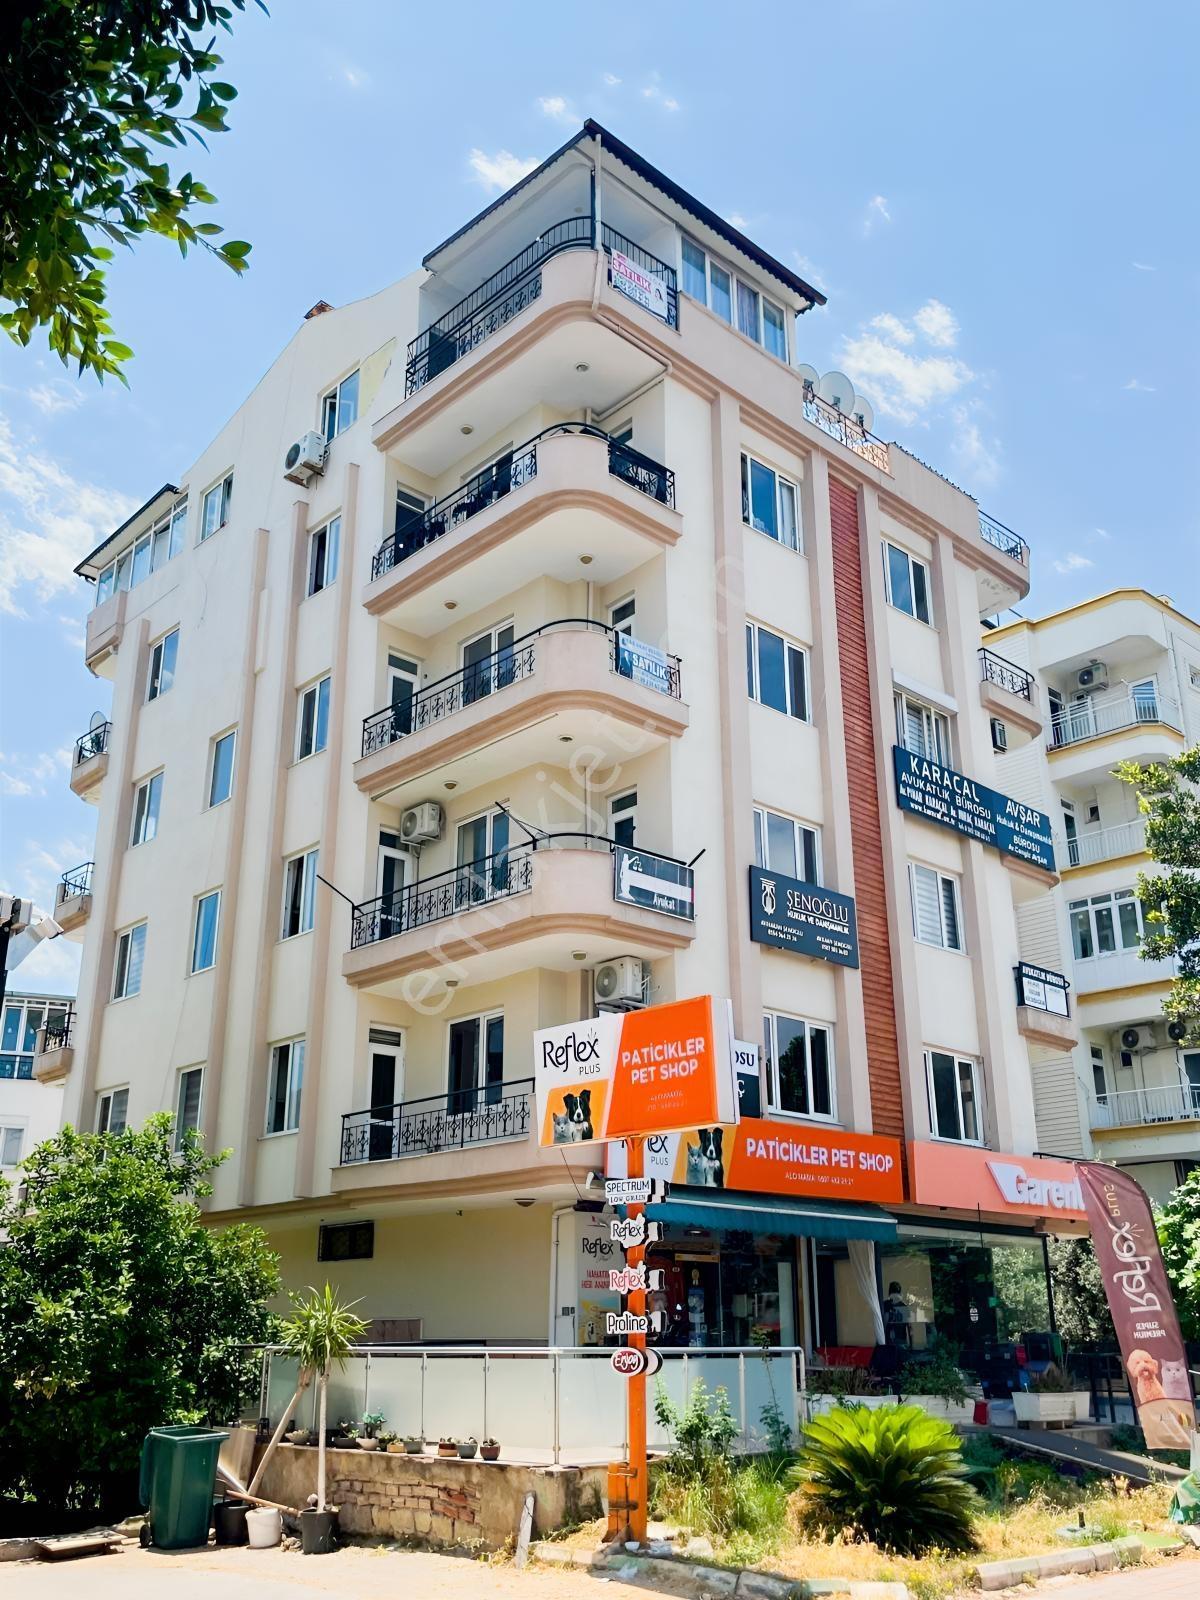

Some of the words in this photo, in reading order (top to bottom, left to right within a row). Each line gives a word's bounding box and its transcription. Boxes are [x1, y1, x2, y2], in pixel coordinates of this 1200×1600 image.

[632, 653, 668, 680] SATILIK
[901, 771, 950, 802] AVUKATLIK
[955, 794, 991, 819] BÜROSU
[1005, 799, 1041, 828] AVŞAR
[786, 889, 848, 923] ŞENOĞLU
[807, 915, 815, 925] VE
[543, 1031, 601, 1073] Reflex
[621, 1037, 705, 1068] PATİCİKLER
[579, 1063, 601, 1076] PLUS
[631, 1066, 656, 1085] PET
[660, 1059, 699, 1082] SHOP
[650, 1156, 669, 1166] PLUS
[746, 1137, 829, 1166] PATİCİKLER
[831, 1148, 856, 1169] PET
[859, 1151, 894, 1173] SHOP
[606, 1180, 650, 1193] SPECTRUM
[612, 1222, 642, 1240] Reflex
[582, 1237, 614, 1258] Reflex
[611, 1271, 643, 1292] Reflex
[608, 1314, 646, 1332] Proline
[614, 1353, 639, 1370] Enjoy
